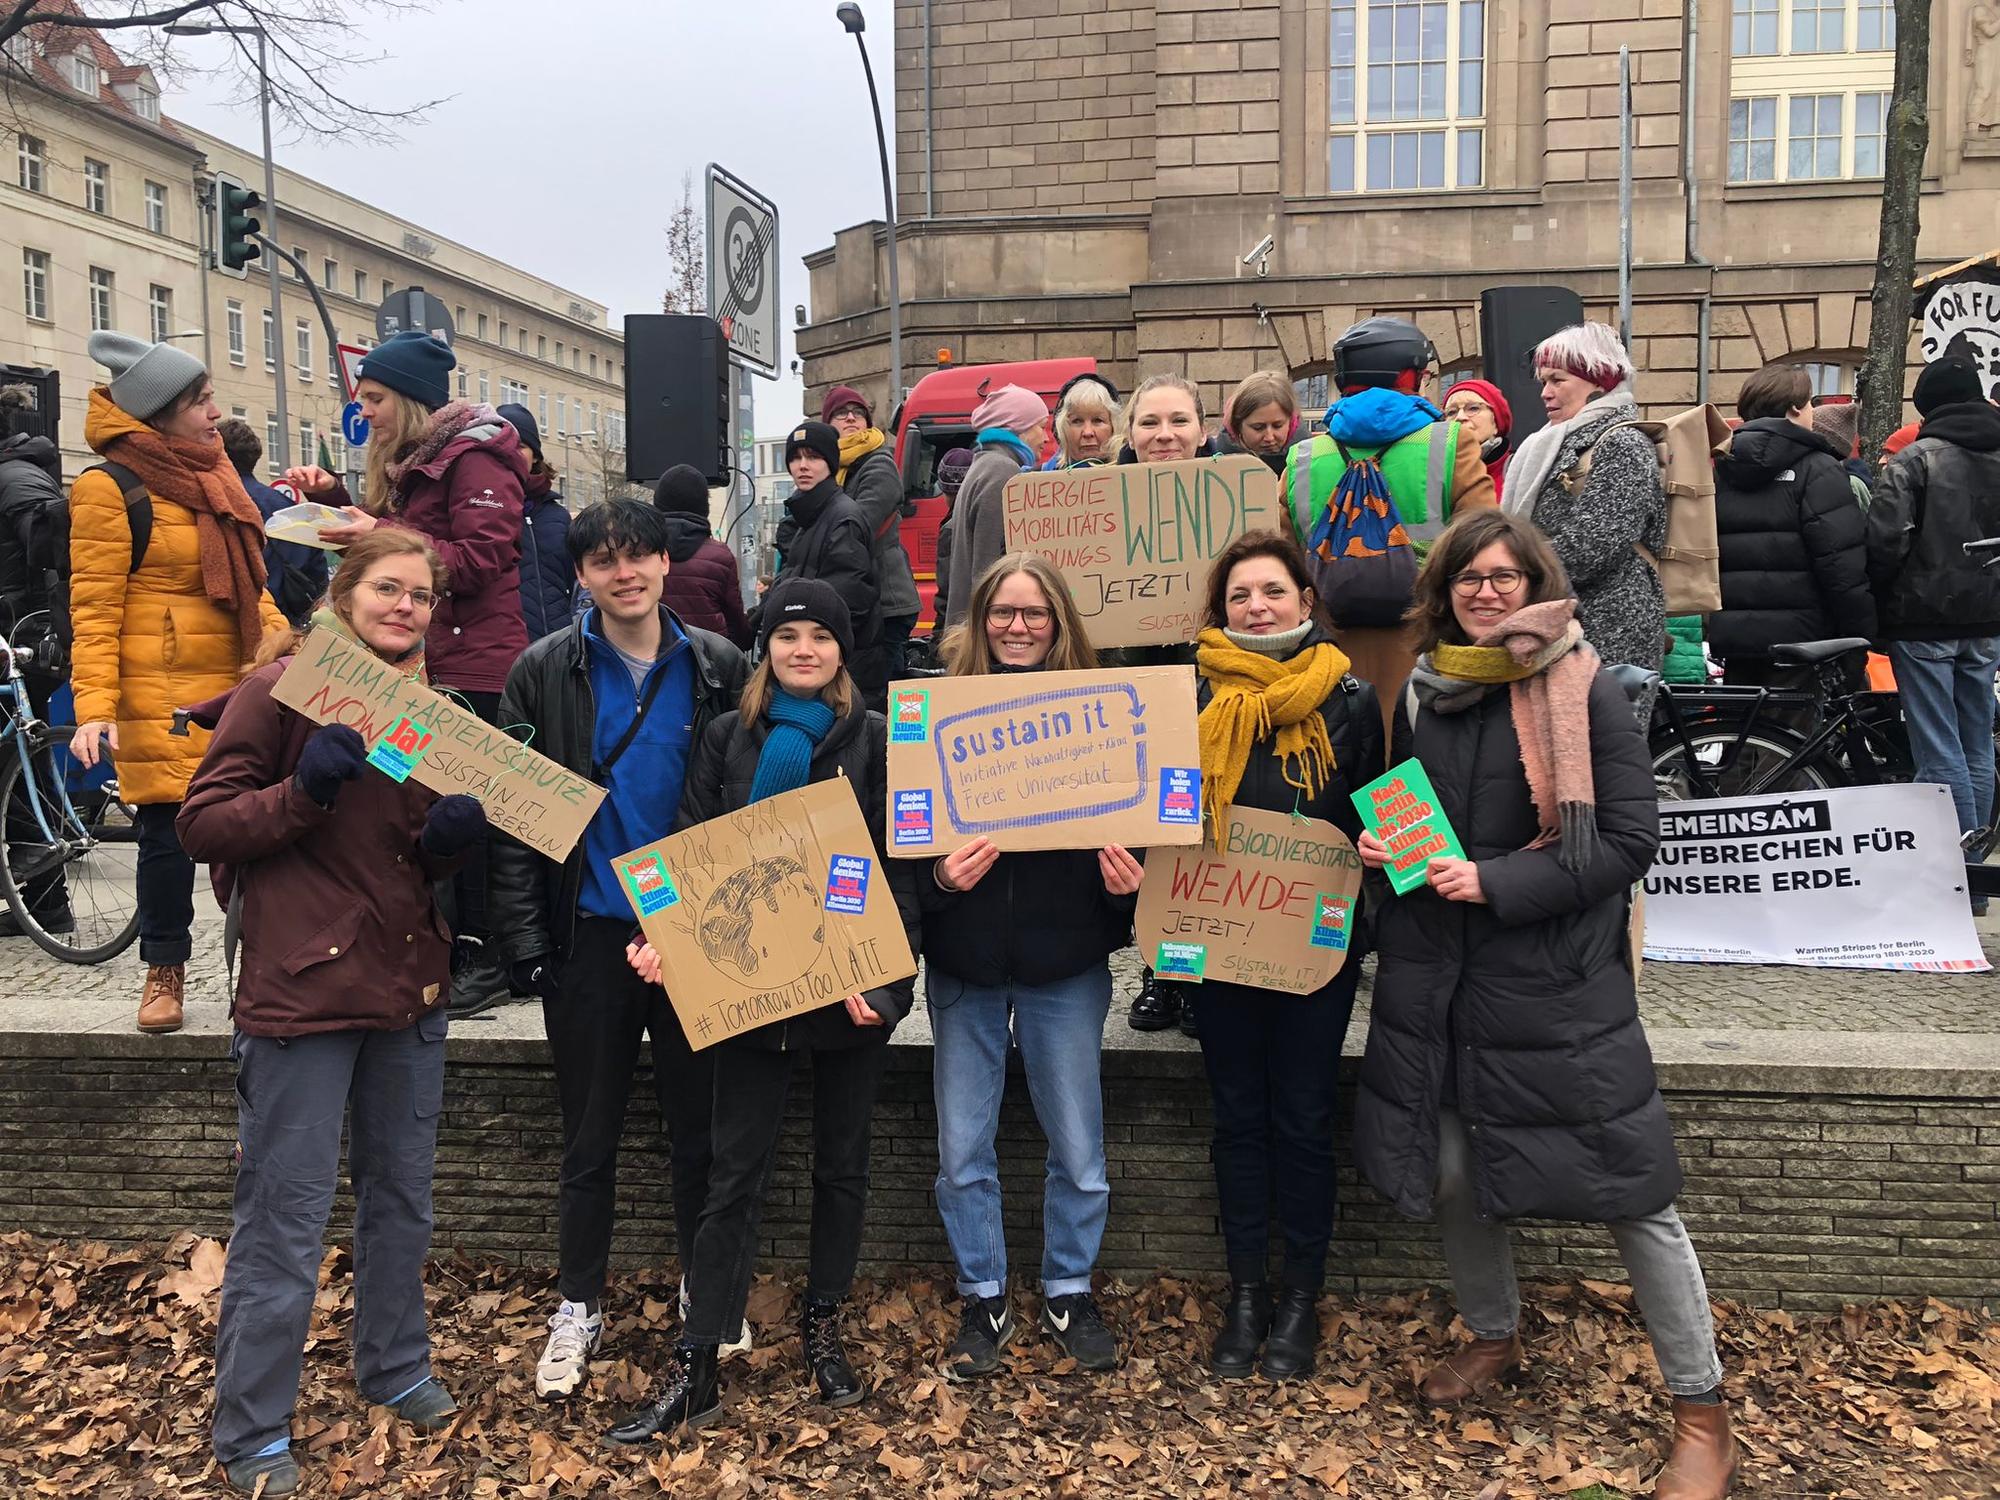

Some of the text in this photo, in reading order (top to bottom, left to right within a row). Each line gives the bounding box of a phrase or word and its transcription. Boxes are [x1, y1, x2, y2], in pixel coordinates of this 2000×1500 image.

[1930, 292, 1968, 331] FOR
[1007, 476, 1113, 513] ENERGIE
[1007, 510, 1117, 547] MOBILITÄTS
[1120, 467, 1267, 566] WENDE
[1078, 571, 1191, 618] JETZT!
[313, 637, 402, 708] KLIMA
[303, 685, 393, 744] NOW
[951, 699, 1110, 764] sustain it
[383, 716, 433, 755] Ja!
[422, 750, 518, 805] SUSTAIN
[515, 799, 547, 823] IT!
[959, 760, 1018, 787] Initiative
[901, 791, 926, 802] Global
[961, 787, 1006, 811] Freie
[1374, 792, 1418, 823] Berlin
[487, 806, 563, 852] BERLIN
[1376, 801, 1432, 841] bis 2030
[1659, 807, 1817, 836] EMEINSAM
[837, 857, 864, 870] Global
[1654, 827, 1916, 866] UFBRECHEN FÜR
[1170, 857, 1315, 919] WENDE
[1643, 867, 1862, 895] UNSERE ERDE.
[643, 891, 678, 915] neutral
[1161, 910, 1255, 946] JETZT!
[828, 937, 889, 991] LATE
[1795, 940, 1926, 955] Warming Stripes for Berlin
[1884, 948, 1935, 958] 1881-2020
[1220, 954, 1287, 977] SUSTAIN
[1296, 967, 1322, 984] IT!
[1235, 972, 1308, 990] FU BERLIN
